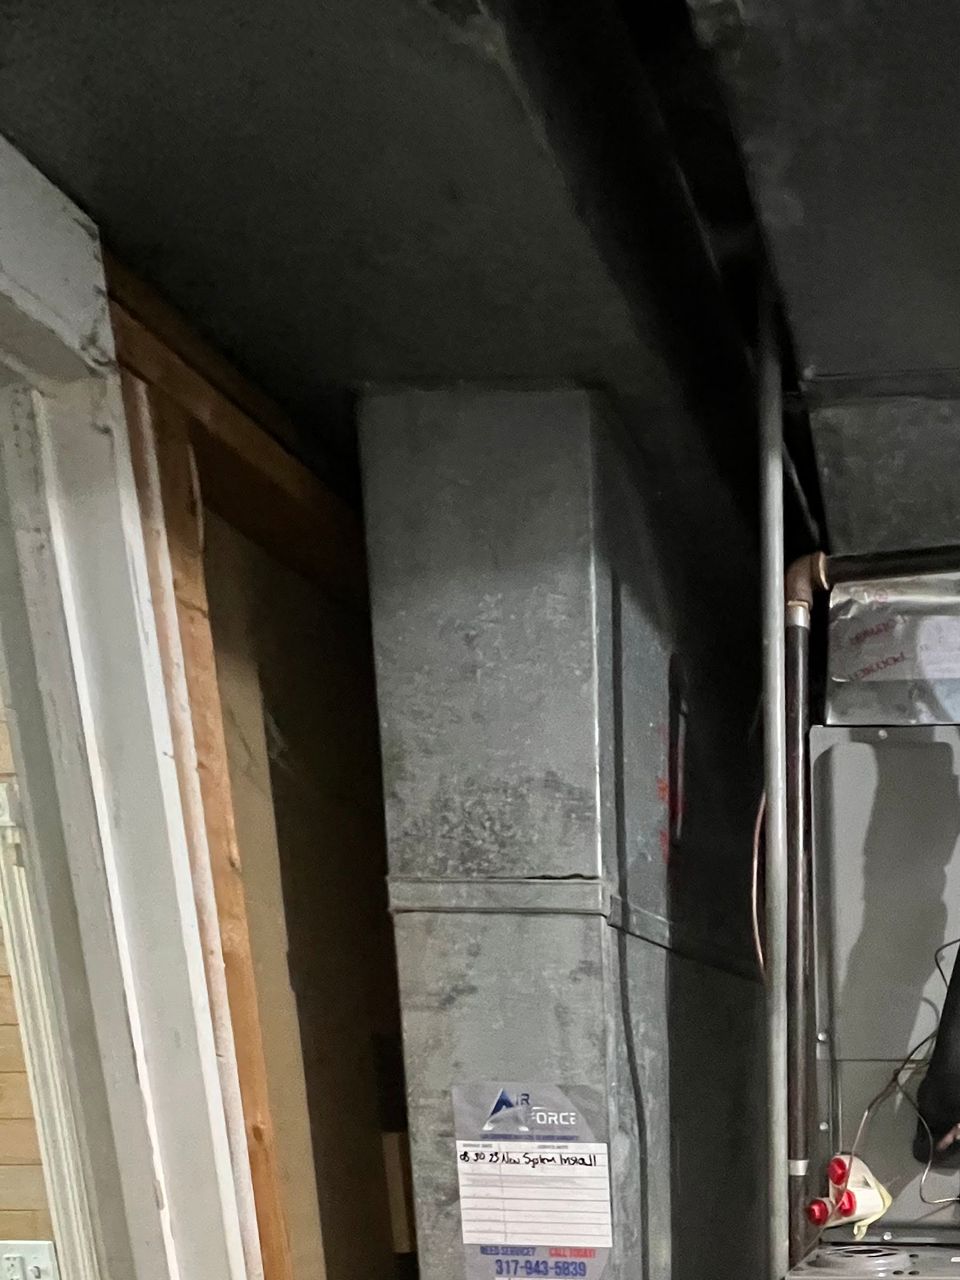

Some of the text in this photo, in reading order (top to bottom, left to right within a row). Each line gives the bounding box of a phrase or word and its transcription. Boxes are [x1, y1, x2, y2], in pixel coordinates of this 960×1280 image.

[473, 1151, 486, 1162] 30
[501, 1151, 520, 1164] New
[495, 1259, 587, 1277] 317-943-5839
